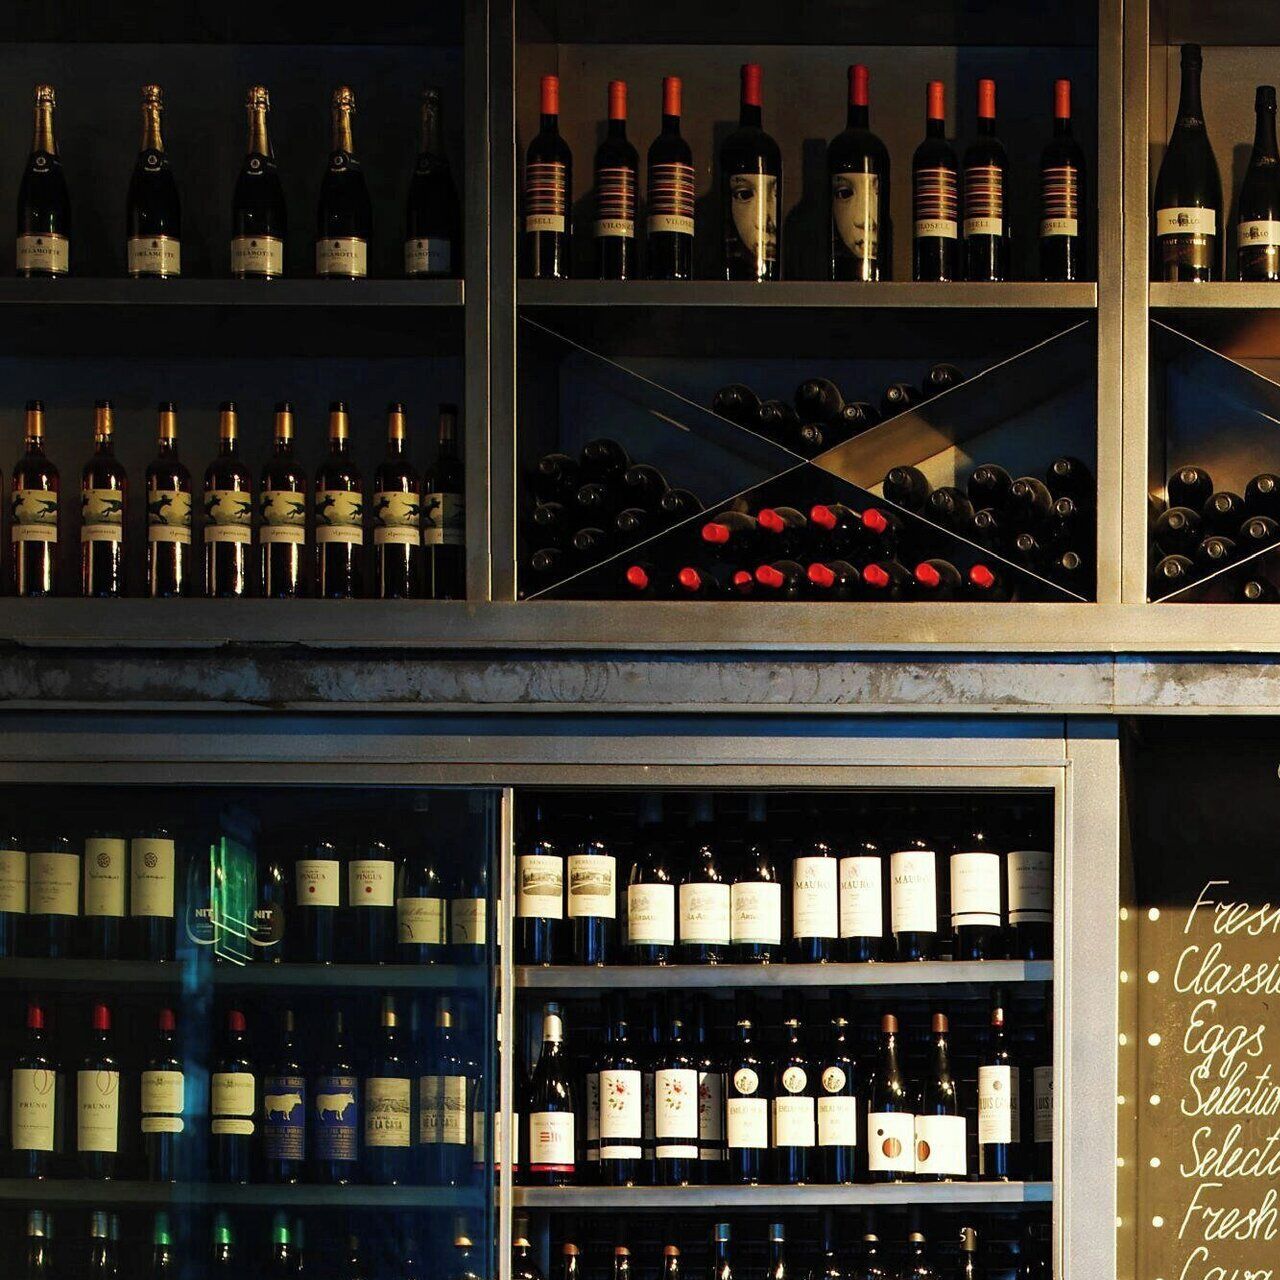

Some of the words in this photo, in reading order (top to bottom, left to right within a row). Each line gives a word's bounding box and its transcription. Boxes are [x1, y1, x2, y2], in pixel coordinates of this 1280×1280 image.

[253, 910, 273, 919] NIT
[1183, 998, 1264, 1079] Eggs
[19, 1101, 47, 1109] PRUNO
[83, 1102, 111, 1110] PRUNO
[1178, 1183, 1278, 1242] Fresh
